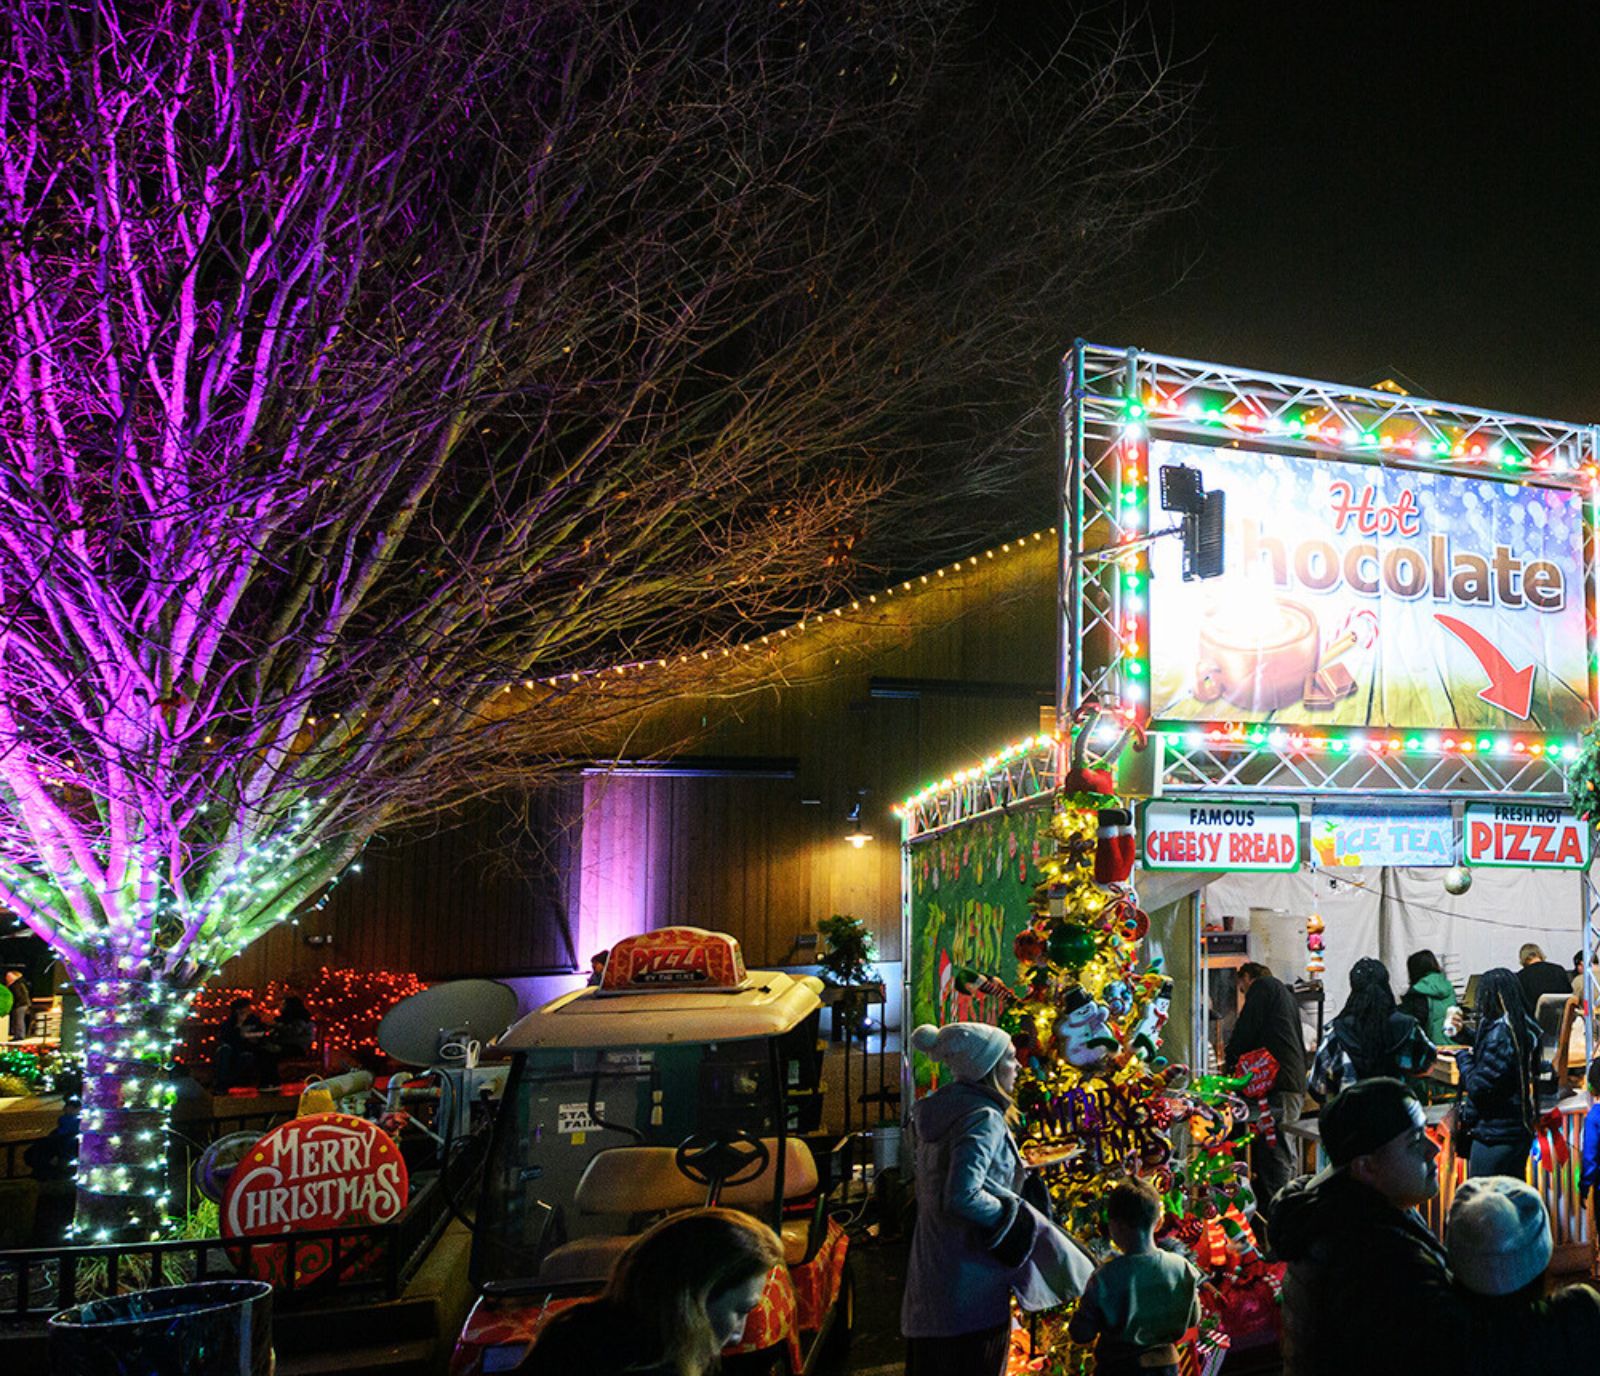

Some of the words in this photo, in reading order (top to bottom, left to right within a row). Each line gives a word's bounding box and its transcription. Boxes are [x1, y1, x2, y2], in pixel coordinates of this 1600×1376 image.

[1329, 481, 1418, 535] Hot
[1226, 517, 1564, 608] hocolate
[1190, 808, 1255, 826] FAMOUS
[1495, 806, 1532, 821] FRESH
[1536, 808, 1562, 823] HOT
[1147, 830, 1222, 862] CHEESY
[1229, 832, 1295, 863] BREAD
[1388, 825, 1446, 855] TEA
[1471, 821, 1584, 863] PIZZA
[633, 947, 708, 974] PIZZA
[559, 1109, 605, 1121] STAE
[261, 1125, 377, 1180] MERRY
[228, 1161, 401, 1237] CHRISTMAS
